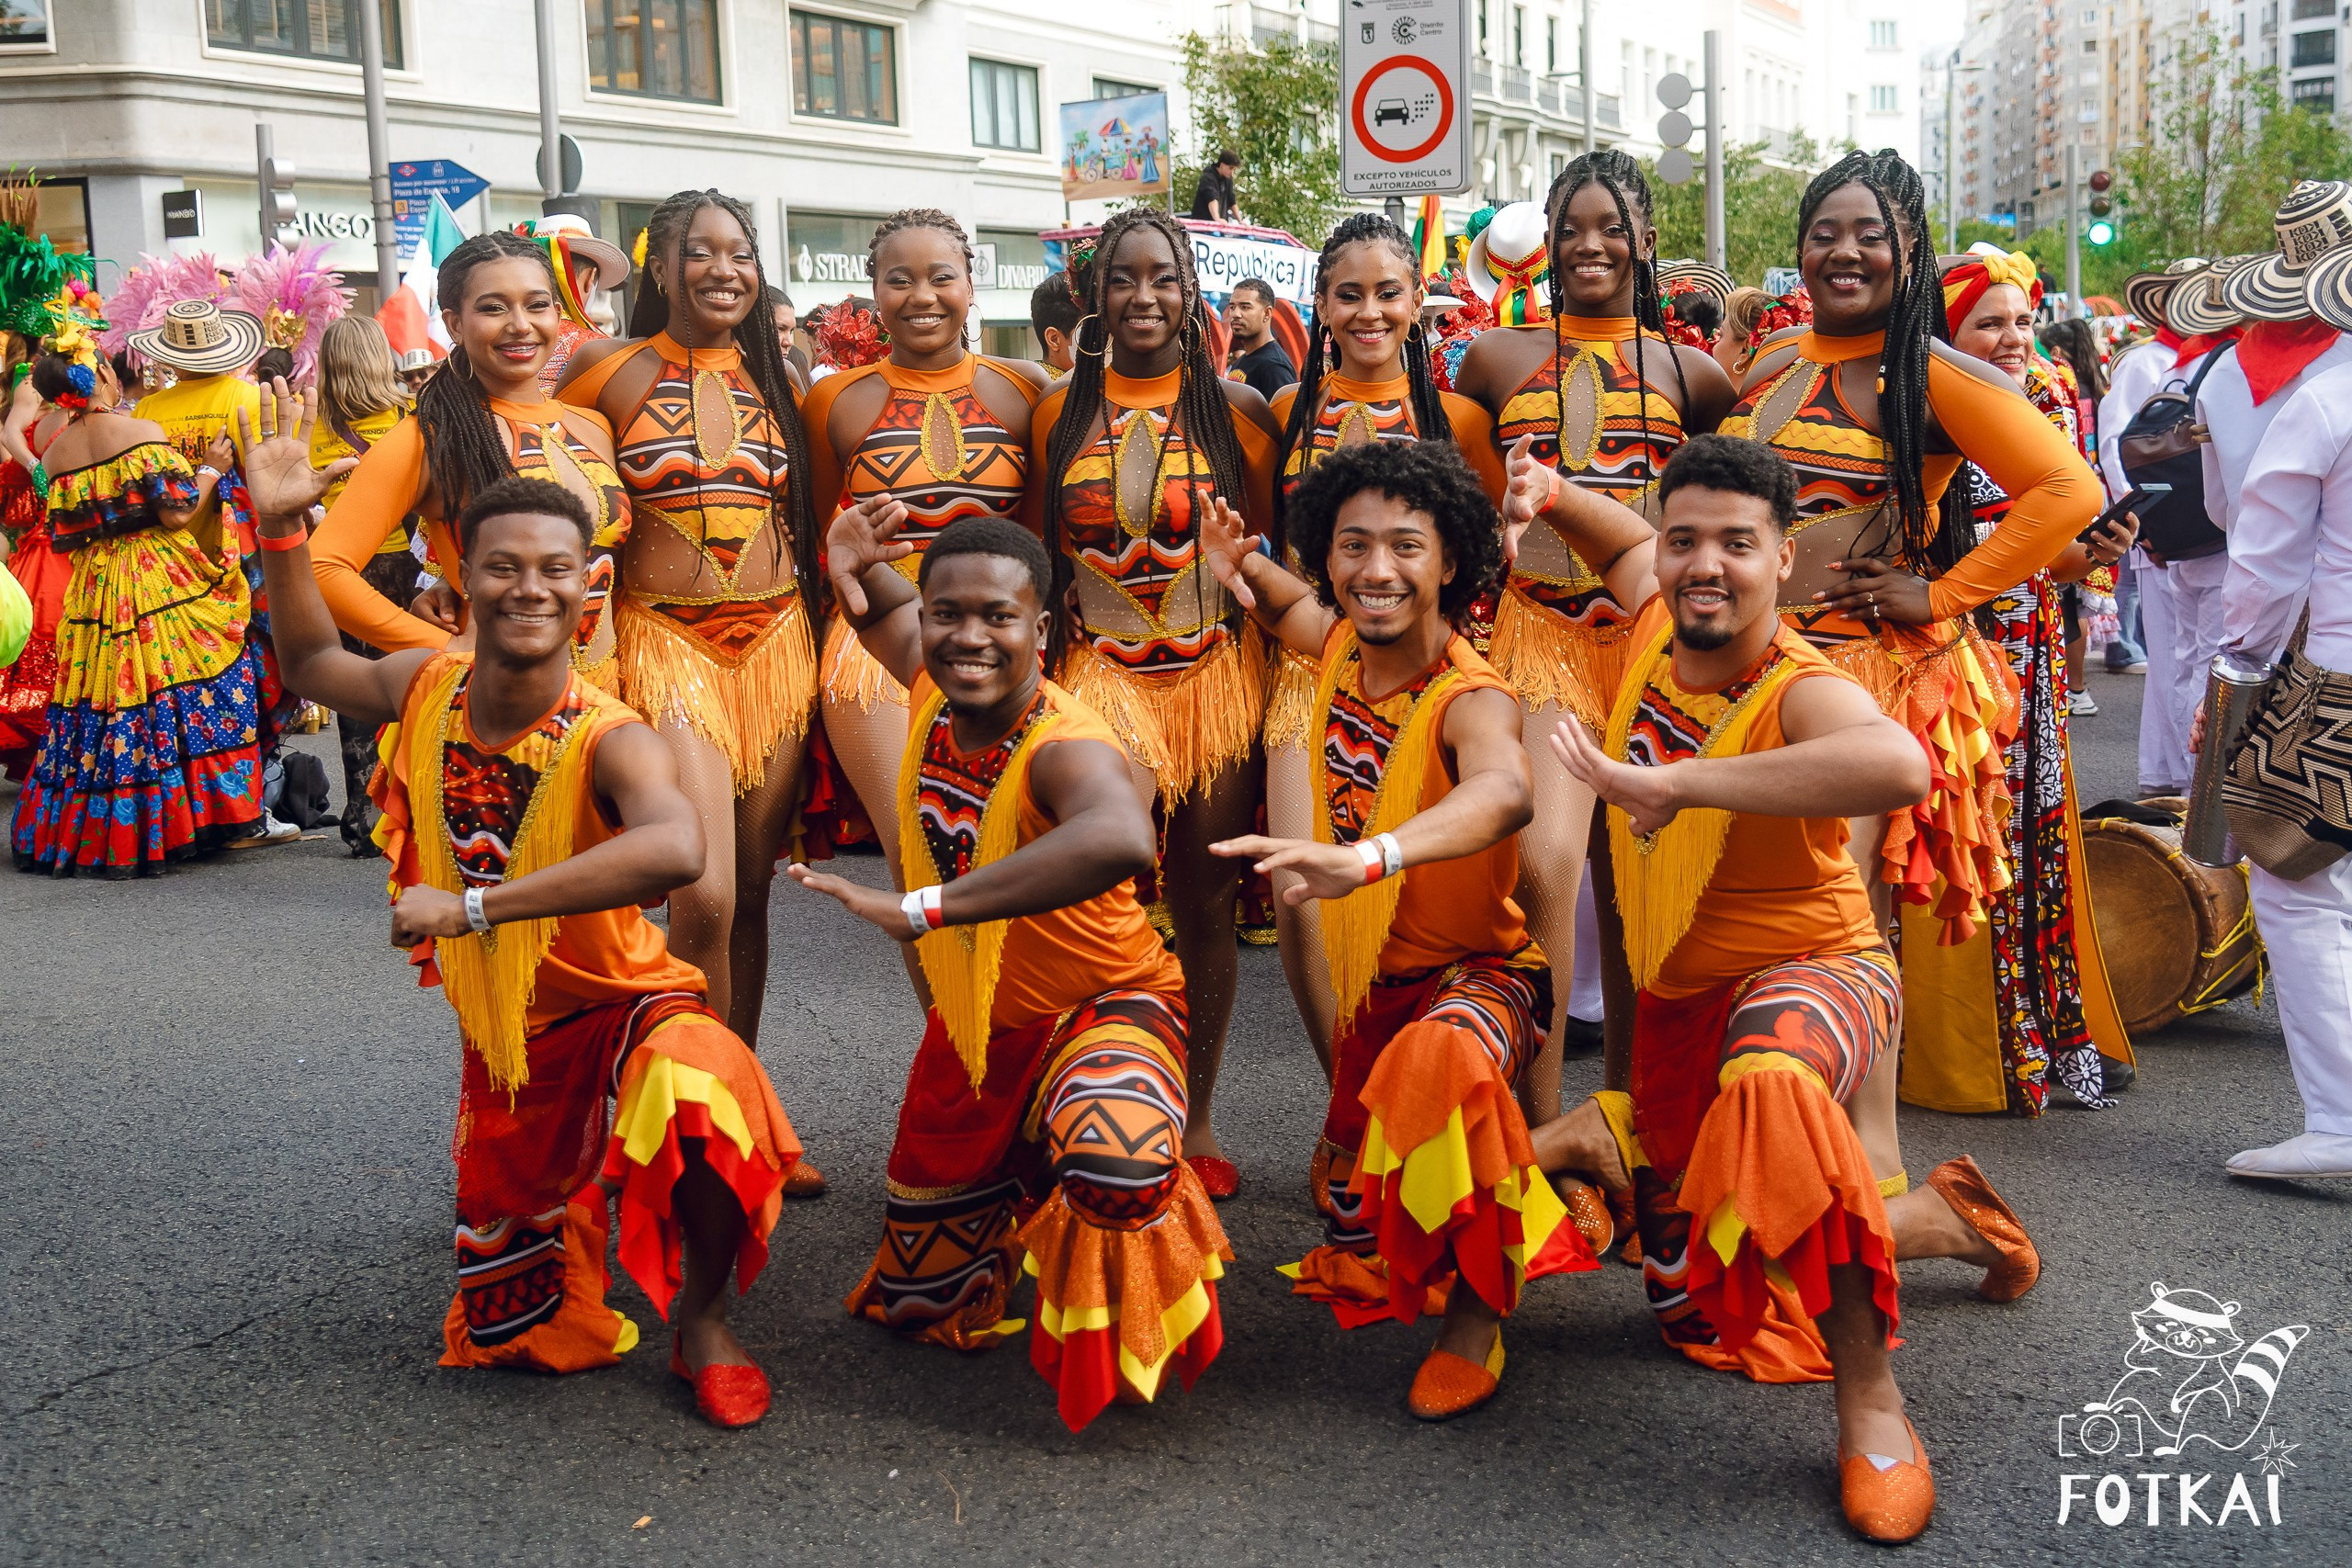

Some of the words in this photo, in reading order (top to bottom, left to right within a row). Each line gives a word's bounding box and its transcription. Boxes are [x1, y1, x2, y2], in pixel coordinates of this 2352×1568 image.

[1353, 172, 1396, 180] EXCEPTO
[1398, 169, 1452, 178] VEHÍCULOS
[1369, 180, 1437, 189] AUTORIZADOS
[166, 208, 196, 220] MANGO
[279, 211, 374, 239] ANGO
[1195, 241, 1295, 286] República
